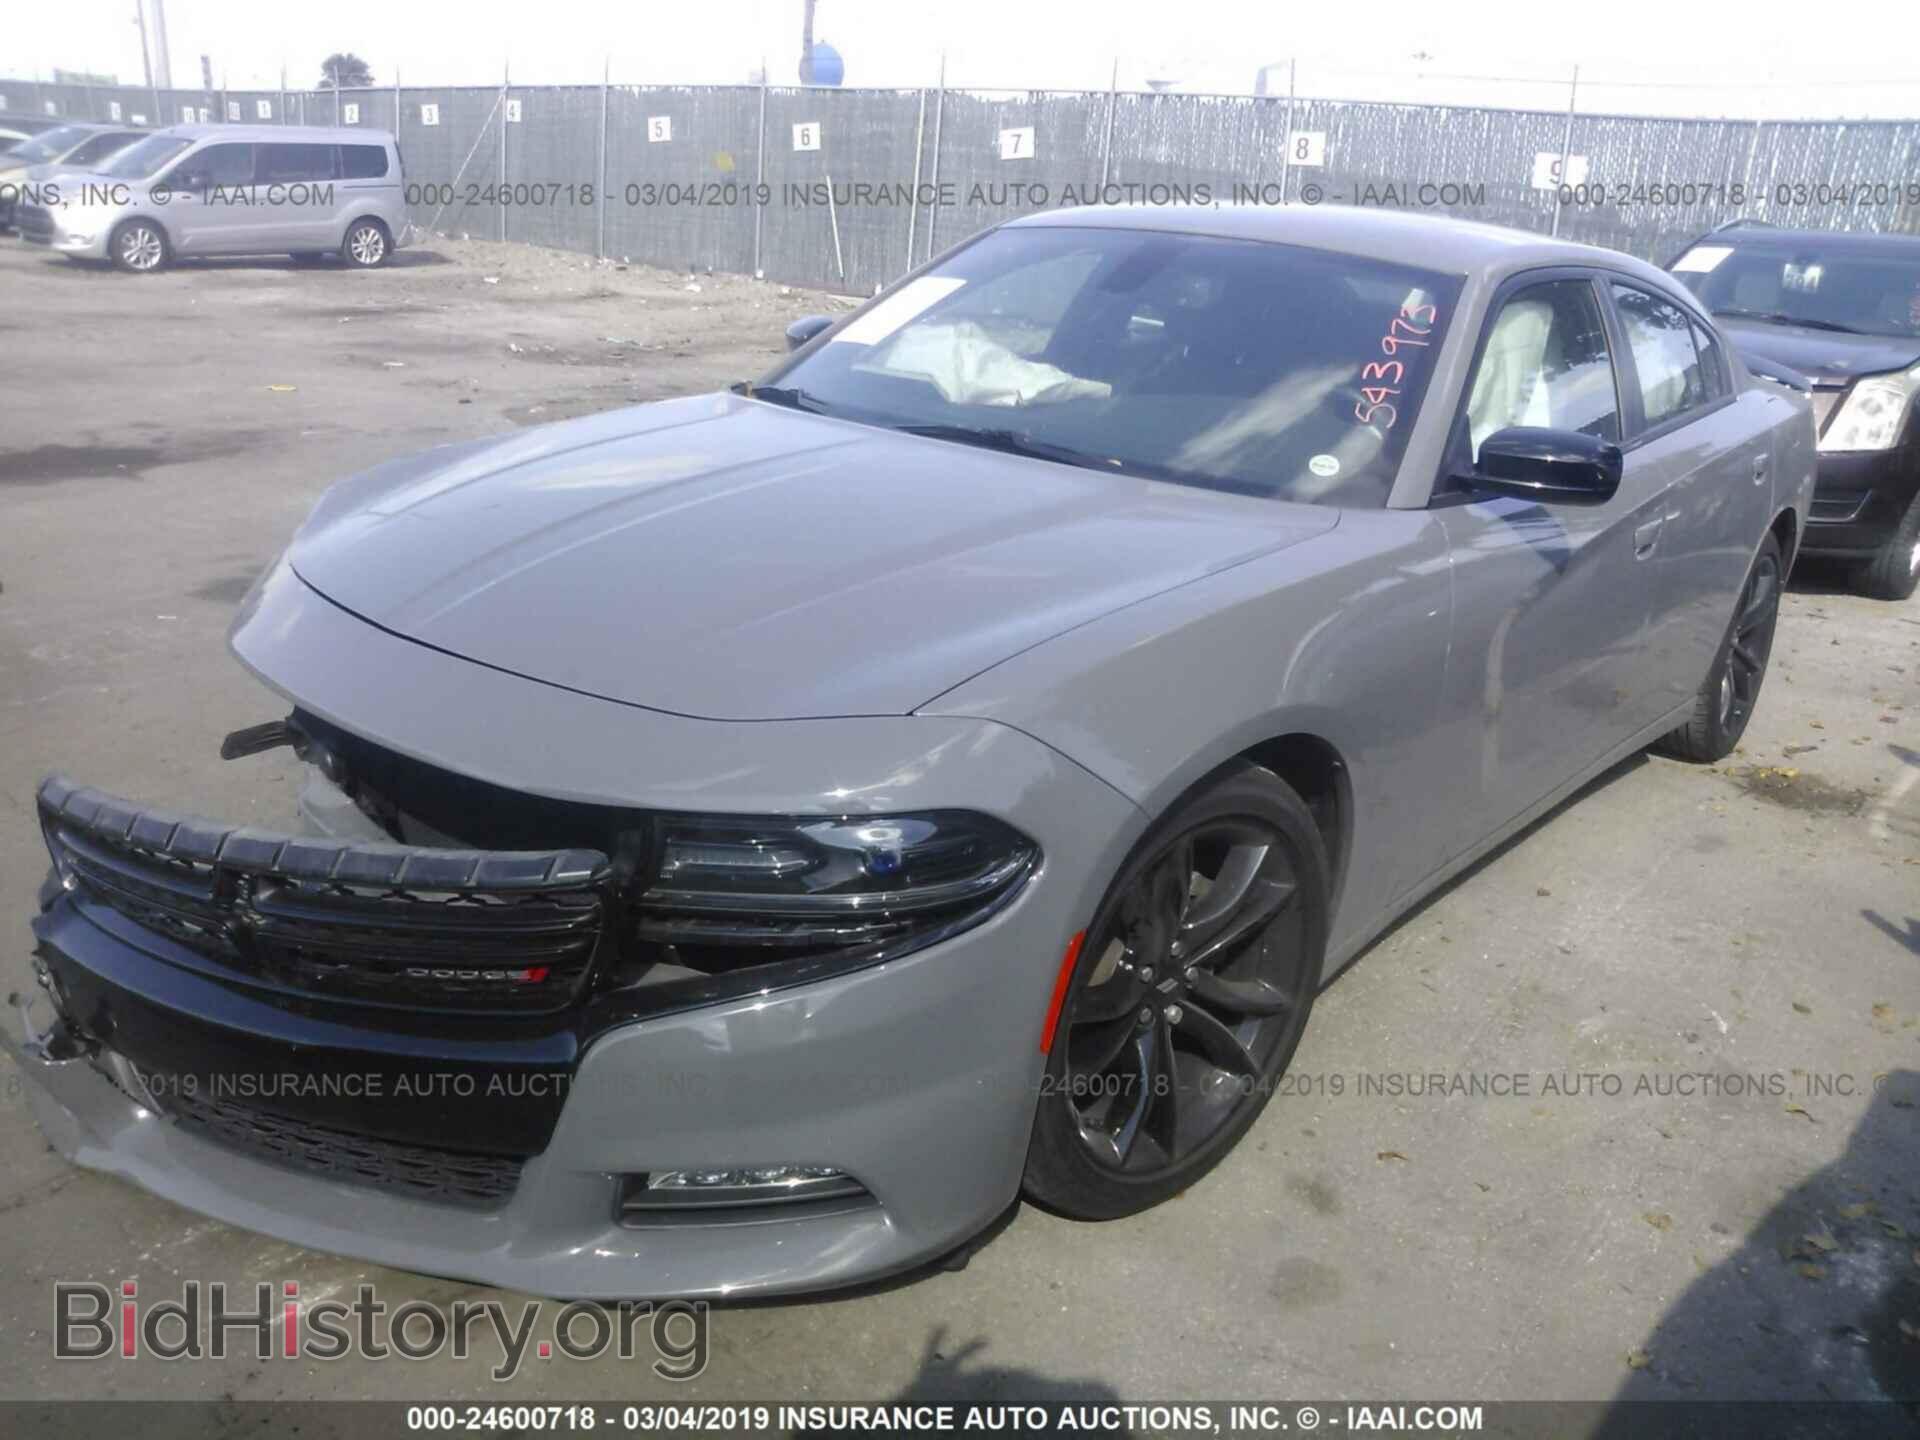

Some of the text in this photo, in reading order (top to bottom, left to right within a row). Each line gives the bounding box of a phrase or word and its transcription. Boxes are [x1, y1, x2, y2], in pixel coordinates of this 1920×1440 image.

[655, 121, 663, 138] 5
[801, 127, 811, 146] 6
[1010, 133, 1024, 154] 7
[1295, 137, 1310, 160] 8
